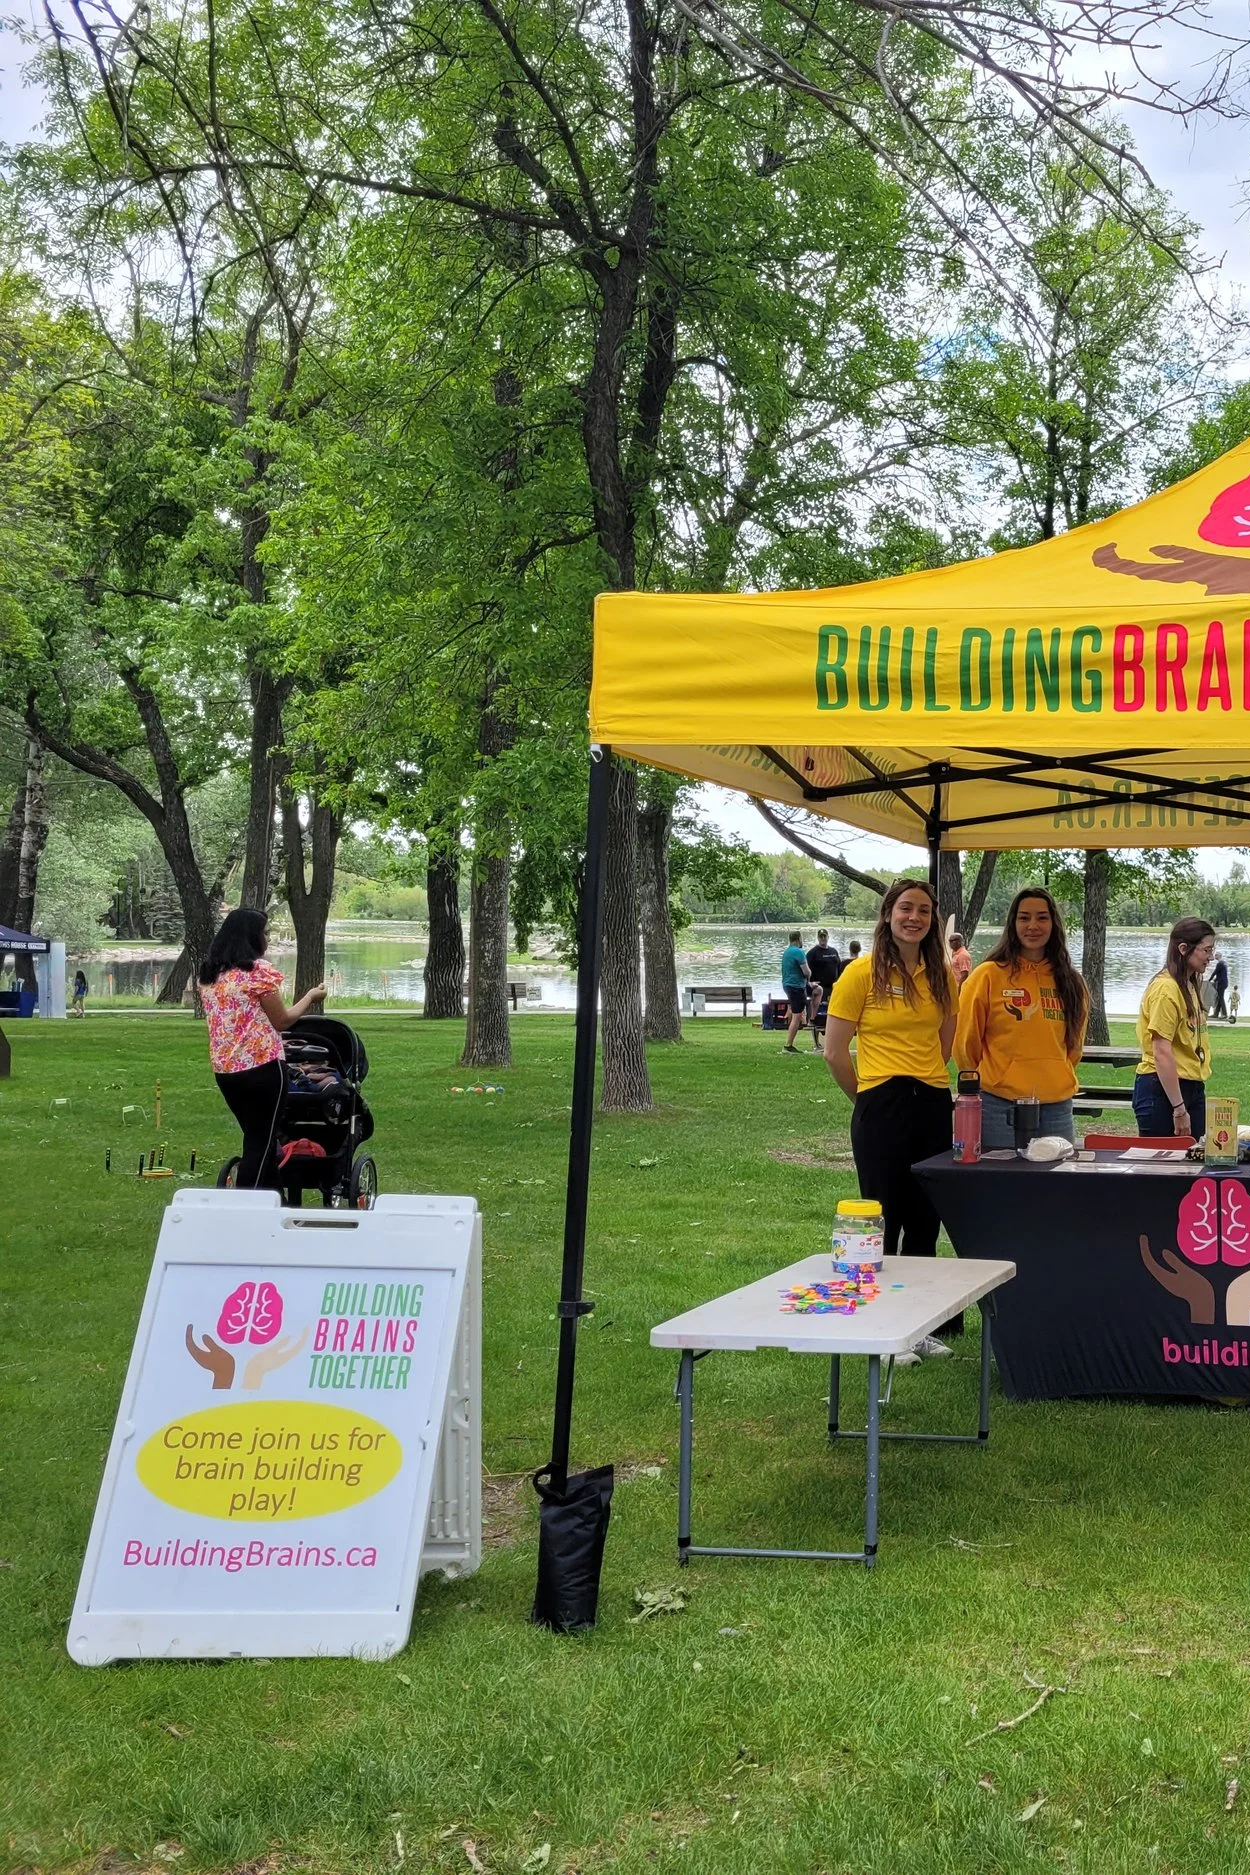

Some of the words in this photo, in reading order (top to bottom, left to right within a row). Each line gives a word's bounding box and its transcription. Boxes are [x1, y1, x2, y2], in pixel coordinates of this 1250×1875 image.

[321, 1282, 424, 1318] BUILDING
[313, 1318, 417, 1353] BRAINS
[309, 1355, 411, 1389] TOGETHER
[163, 1426, 243, 1449] Come
[246, 1427, 301, 1455] join
[310, 1432, 340, 1451] us
[347, 1427, 387, 1451] for
[175, 1455, 244, 1480] brain
[253, 1456, 364, 1487] building
[228, 1486, 297, 1516] play!
[123, 1539, 377, 1573] BuildingBrains.ca
